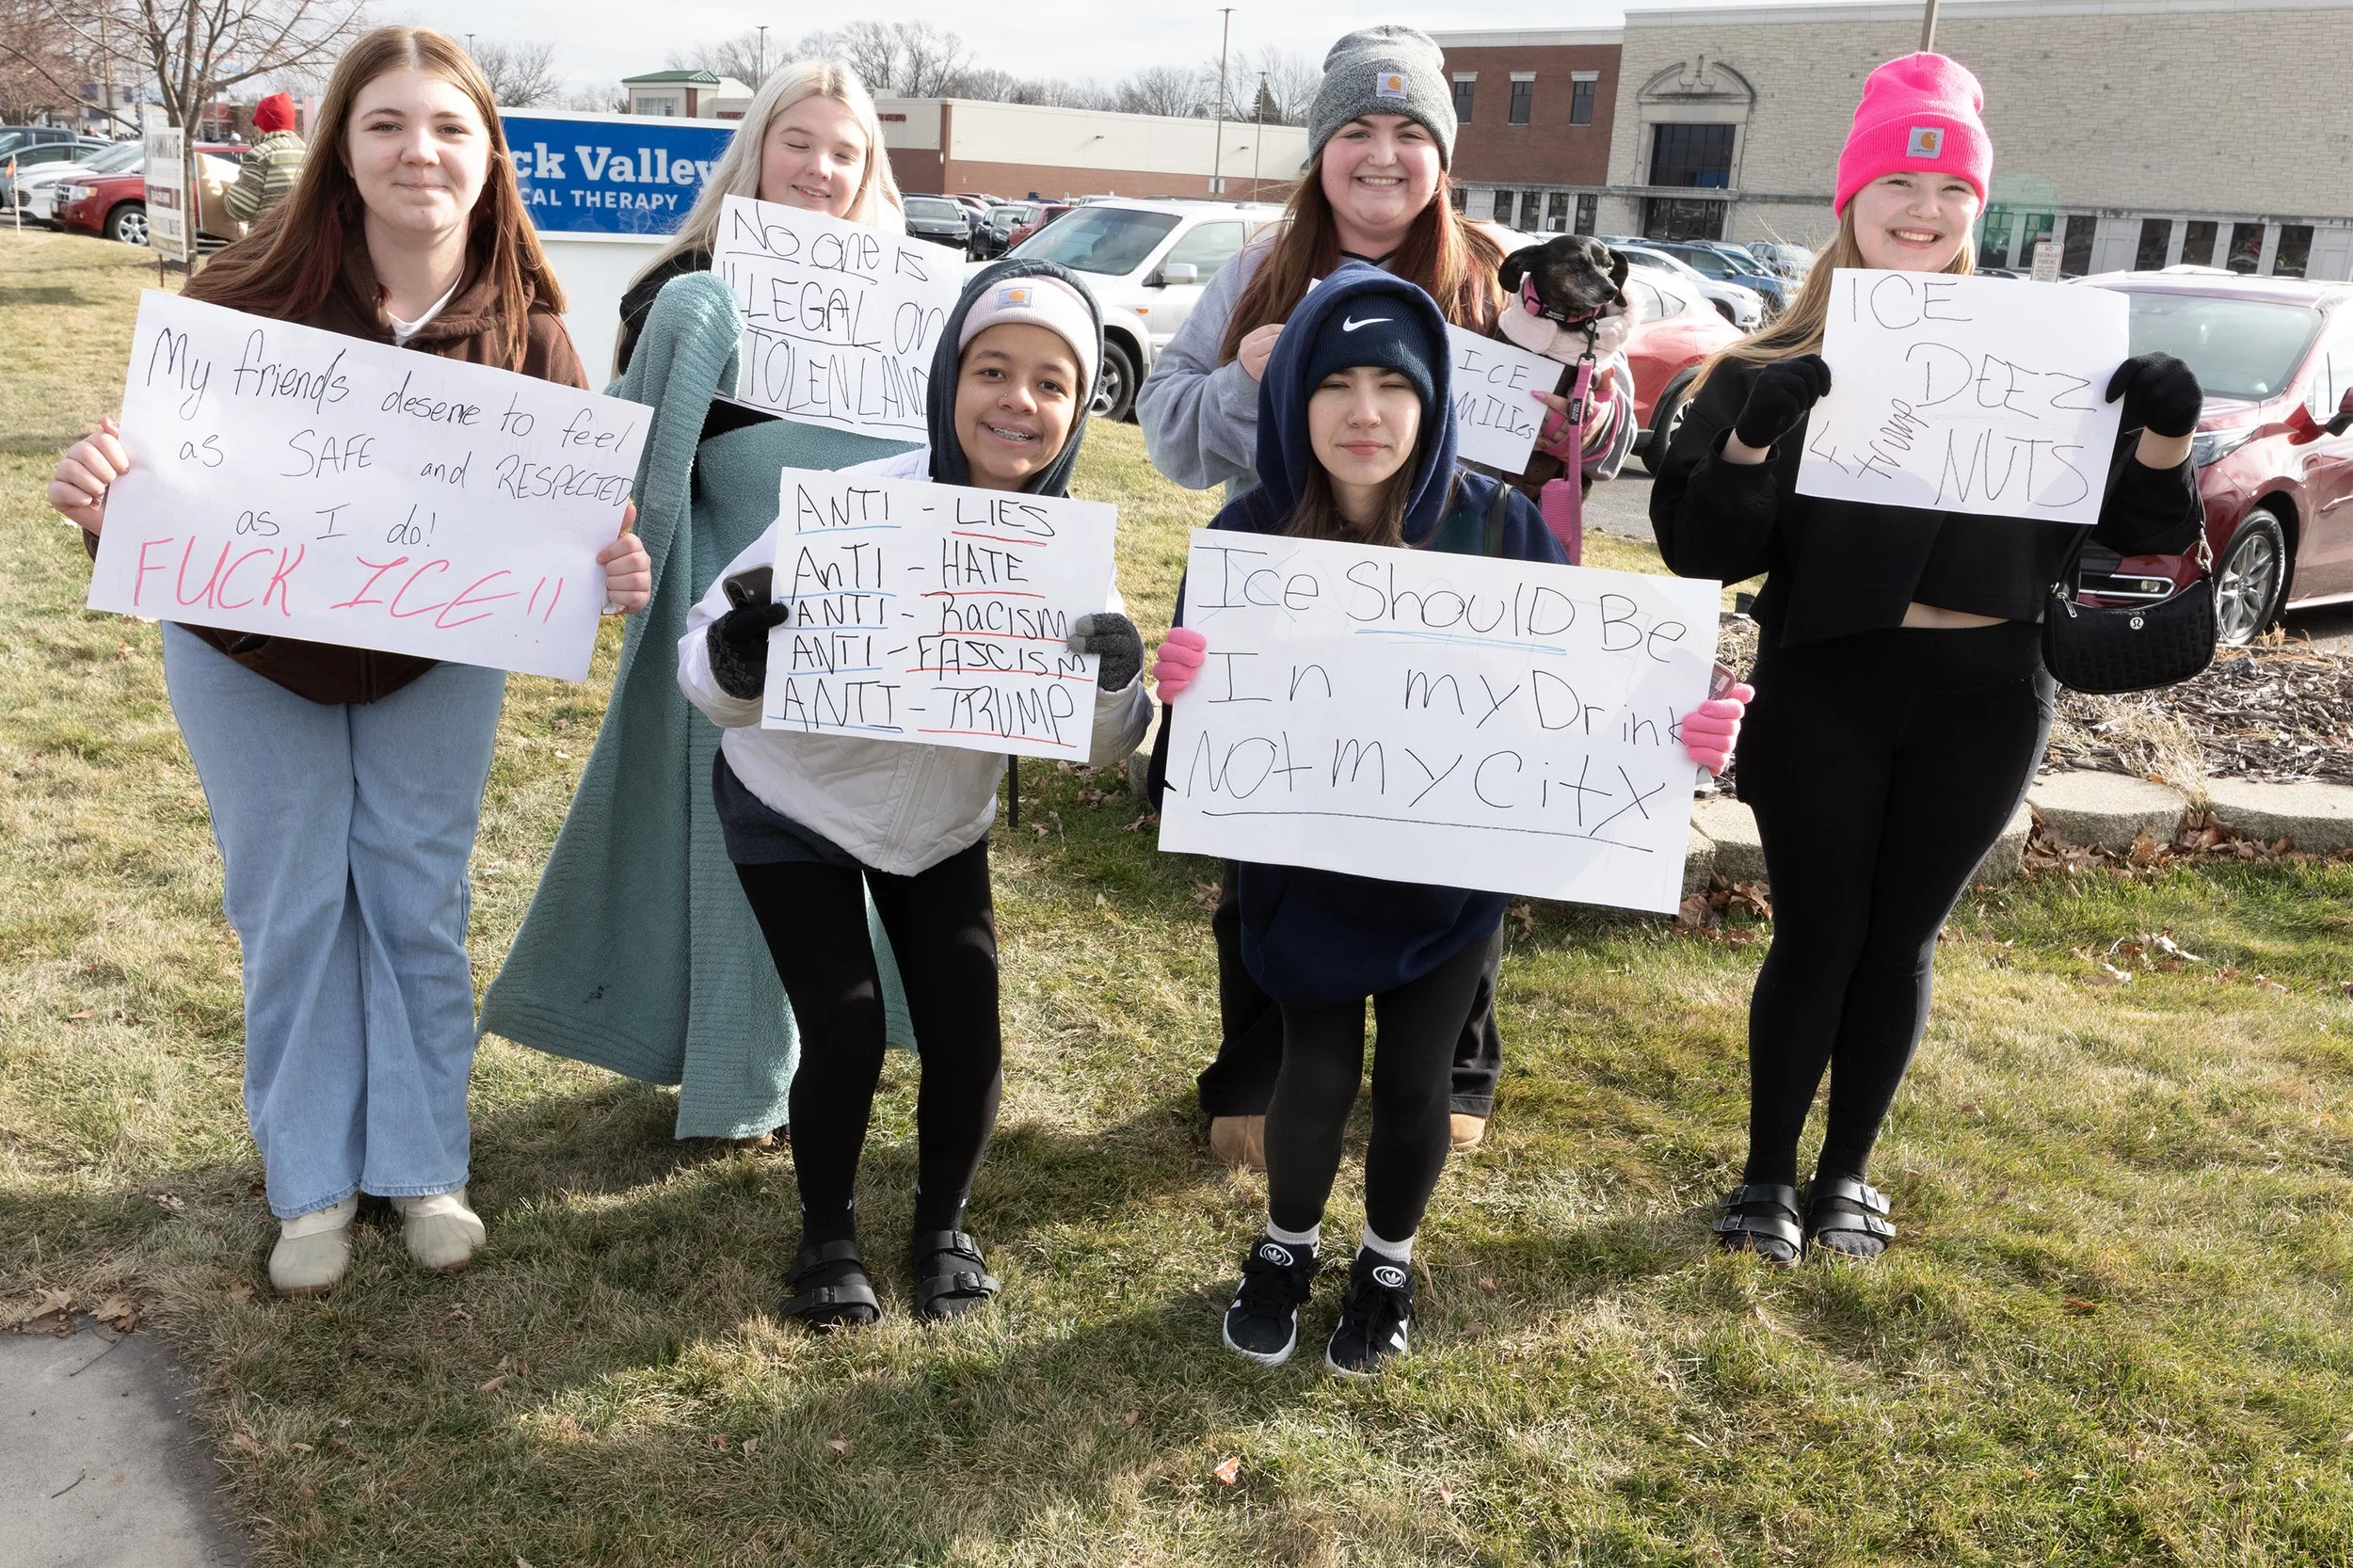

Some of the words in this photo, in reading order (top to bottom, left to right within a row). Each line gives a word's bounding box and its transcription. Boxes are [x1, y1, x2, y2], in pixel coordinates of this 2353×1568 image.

[570, 190, 679, 211] THERAPY
[735, 201, 800, 257] No
[1852, 274, 1973, 329] ICE
[147, 327, 208, 420] My
[233, 328, 349, 414] friends
[501, 392, 535, 437] to
[562, 408, 635, 452] feel
[1458, 348, 1529, 392] ICE
[1906, 343, 2097, 419] DEEZ
[179, 433, 224, 468] as
[280, 429, 375, 477] SAFE
[420, 452, 466, 487] and
[496, 455, 634, 506] RESPECTED
[1934, 428, 2089, 507] NUTS
[236, 510, 280, 536] as
[315, 503, 352, 539] I
[386, 504, 436, 547] do!
[798, 483, 889, 532] ANTI
[956, 497, 1055, 536] LIES
[133, 535, 306, 617] FUCK
[941, 537, 1029, 588] HATE
[798, 593, 884, 627] ANTI
[1194, 545, 1319, 611] Ice
[1599, 594, 1687, 663] Be
[792, 631, 871, 674] ANTI
[917, 634, 1087, 680] FASCISM
[1208, 650, 1332, 703] In
[783, 677, 904, 733] ANTI
[931, 683, 1075, 744] TRUMP
